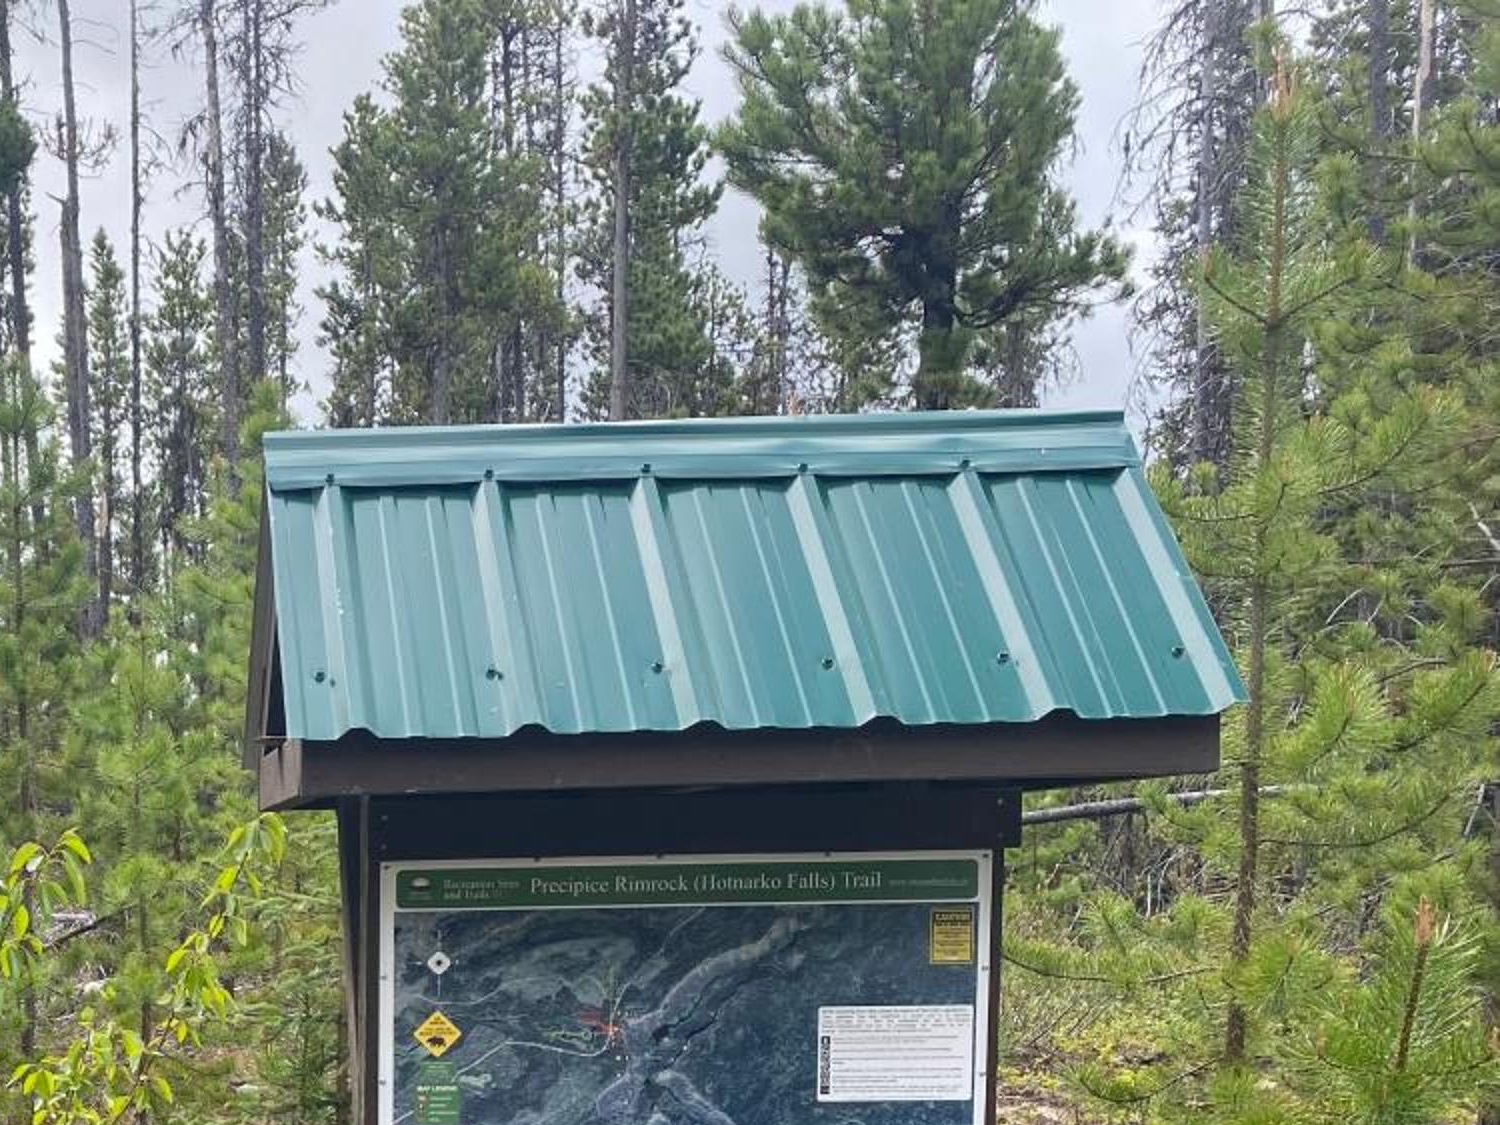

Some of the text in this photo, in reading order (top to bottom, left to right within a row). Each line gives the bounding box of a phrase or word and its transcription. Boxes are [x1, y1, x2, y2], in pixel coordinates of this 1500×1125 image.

[531, 877, 609, 897] Precipice
[615, 875, 688, 892] Rimrock
[694, 874, 781, 891] (Hotnarko
[788, 872, 835, 890] Falls)
[842, 871, 881, 888] Trail
